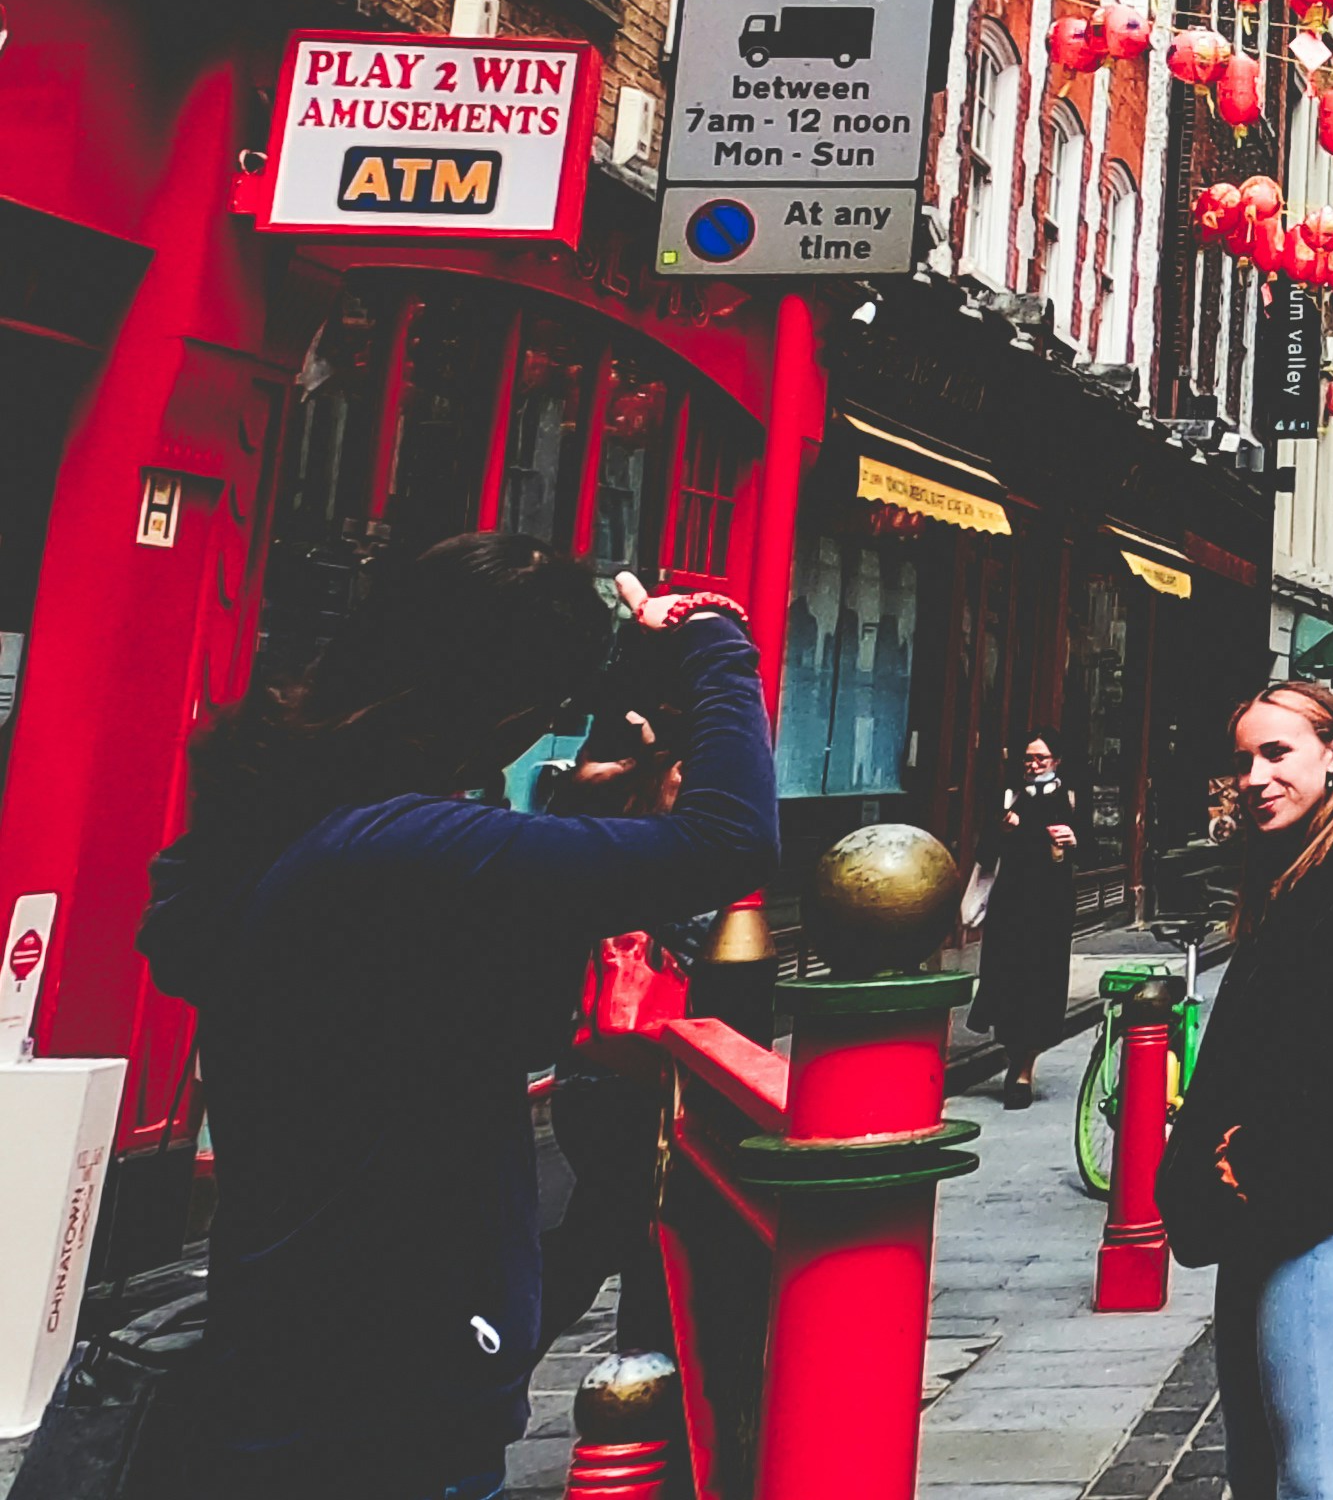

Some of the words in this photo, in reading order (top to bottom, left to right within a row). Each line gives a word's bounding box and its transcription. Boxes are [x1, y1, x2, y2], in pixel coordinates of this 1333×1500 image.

[305, 50, 425, 90] PLAY
[434, 62, 457, 92] 2
[473, 55, 567, 96] WIN
[732, 75, 870, 101] between
[298, 96, 562, 136] AMUSEMENTS
[685, 108, 756, 135] 7am
[786, 108, 821, 135] 12
[832, 112, 911, 135] noon
[713, 140, 783, 167] Mon
[811, 141, 875, 167] Sun
[342, 156, 493, 204] ATM
[784, 200, 823, 227] At
[834, 205, 892, 234] any
[799, 233, 872, 262] time
[1283, 329, 1307, 396] valley
[46, 1186, 86, 1334] CHINATOWN
